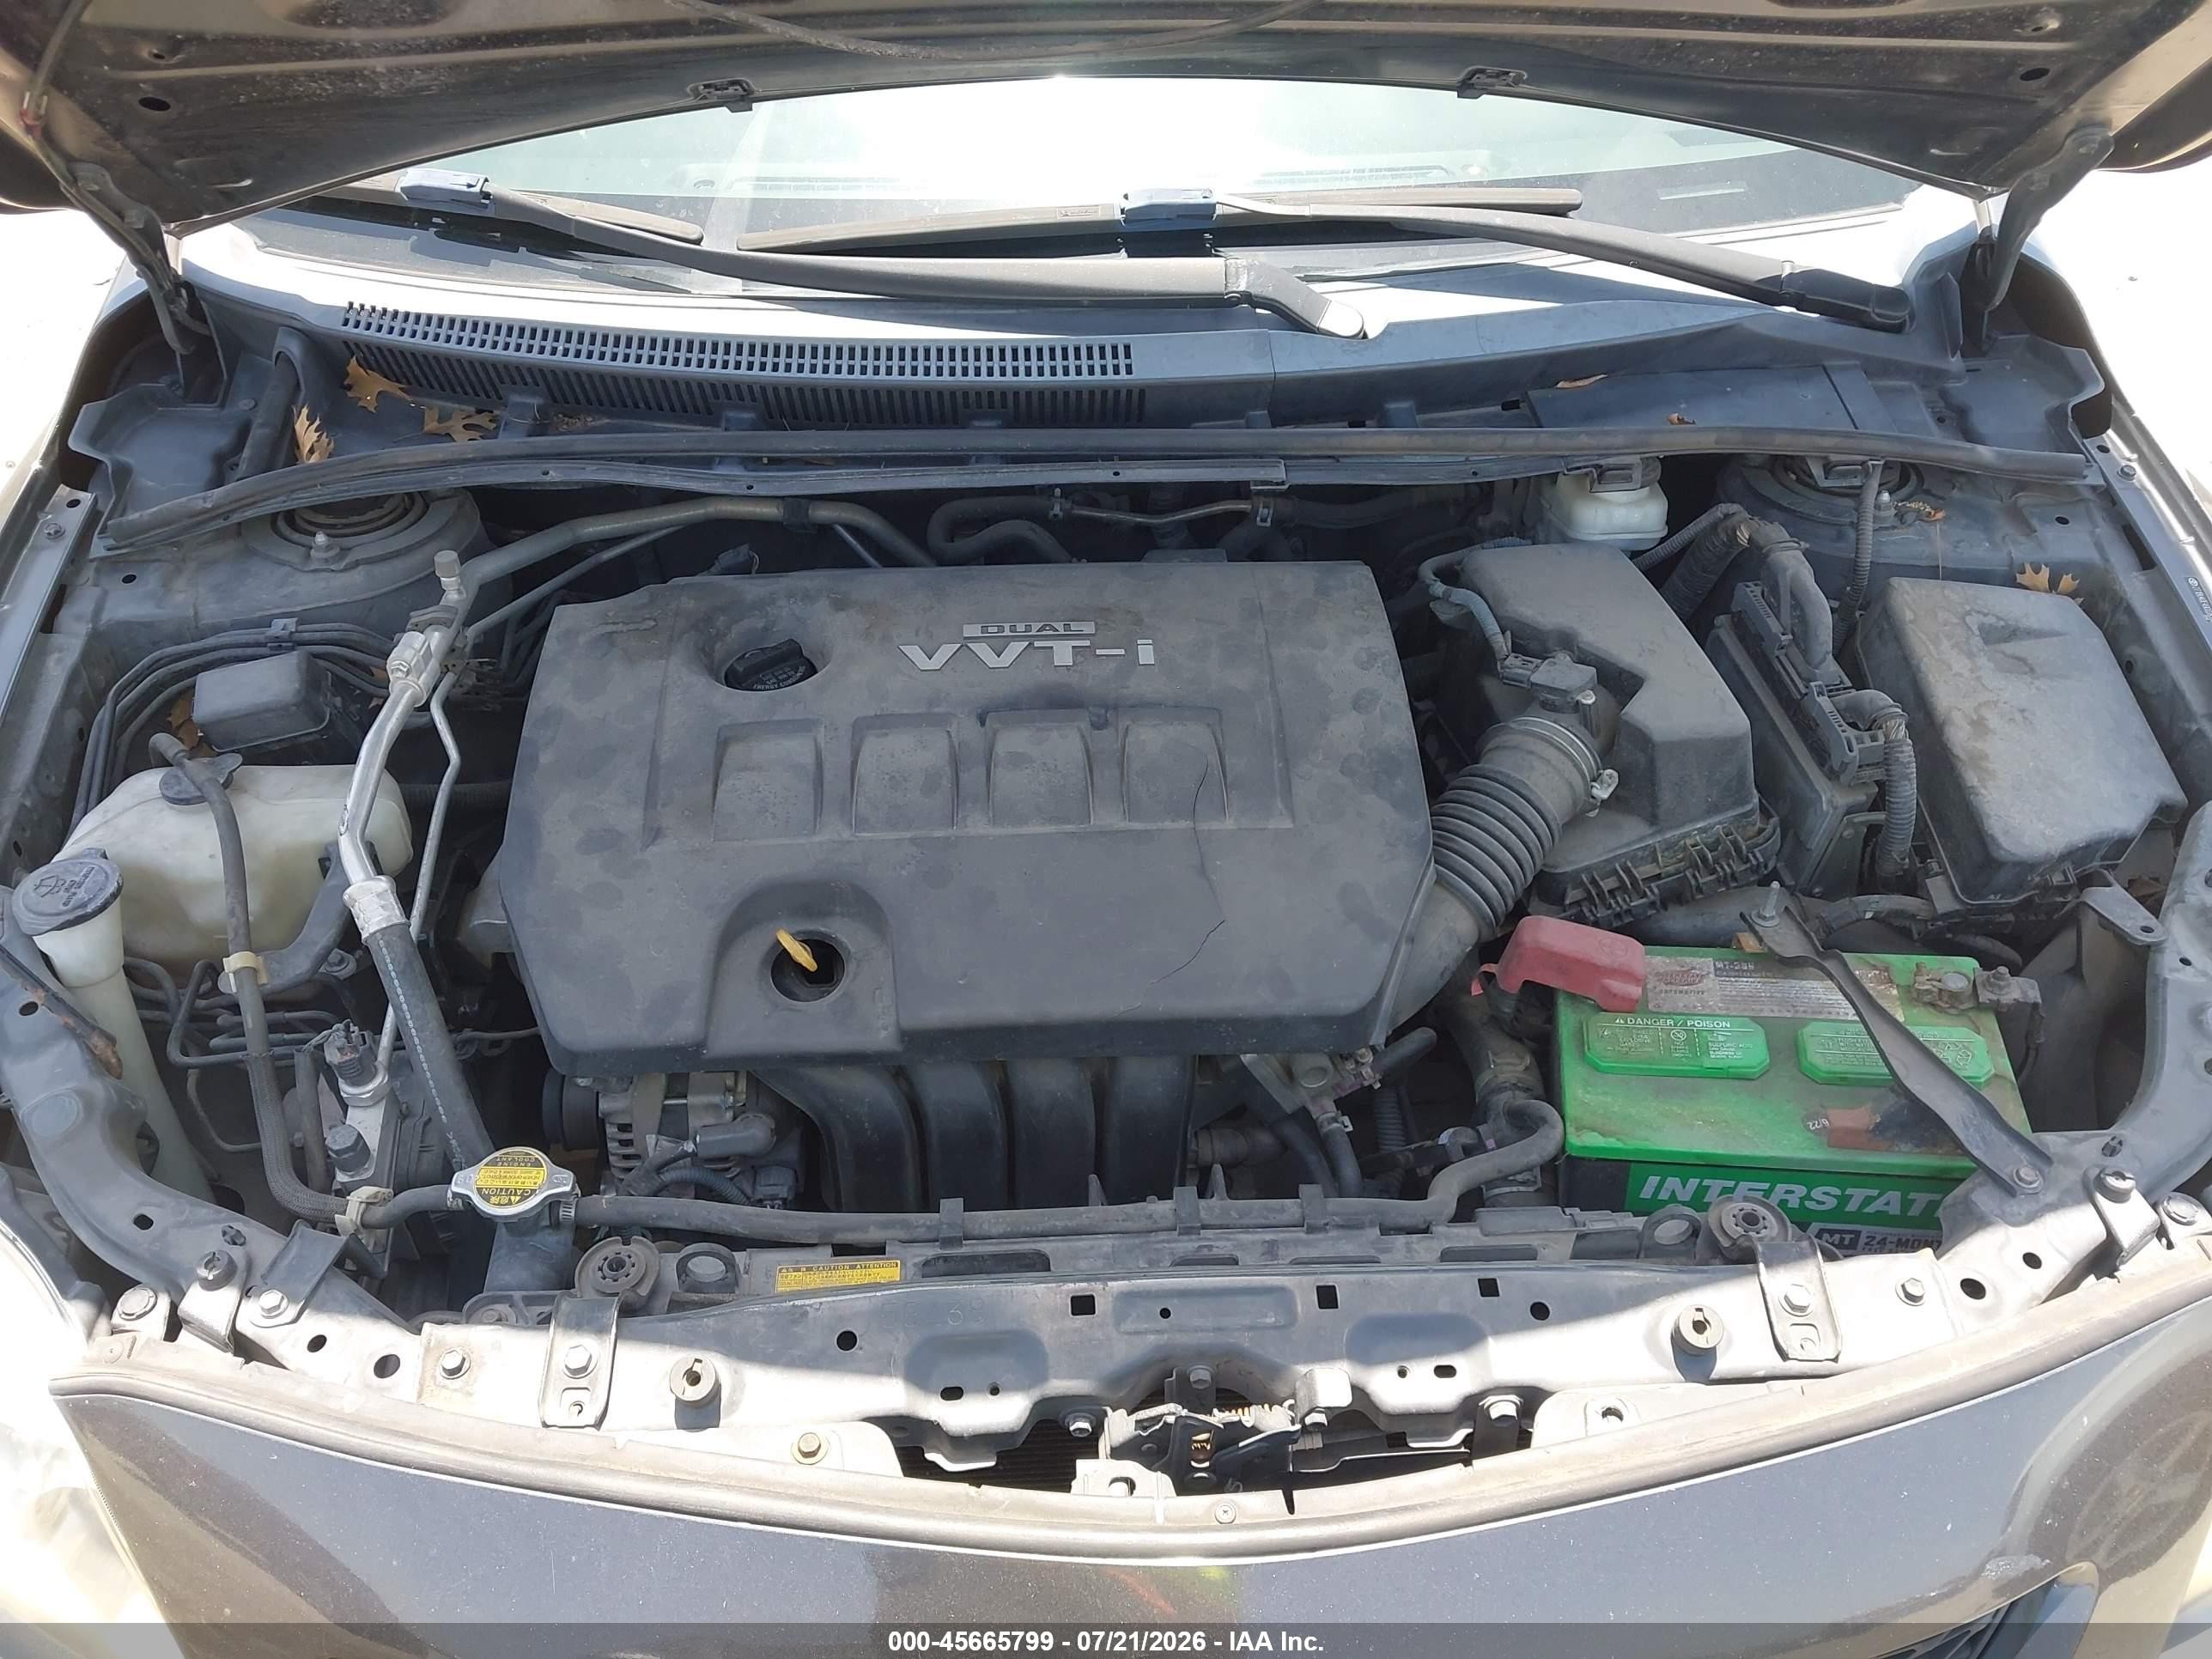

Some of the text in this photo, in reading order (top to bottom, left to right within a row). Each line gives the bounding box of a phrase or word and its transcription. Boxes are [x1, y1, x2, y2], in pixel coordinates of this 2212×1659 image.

[981, 623, 1084, 634] DUAL
[898, 639, 1155, 671] VVT-i
[1627, 1017, 1674, 1026] DANGER
[1687, 1019, 1731, 1028] POISON
[1639, 1175, 1942, 1218] INTERSTAT
[1822, 1233, 1855, 1246] MT
